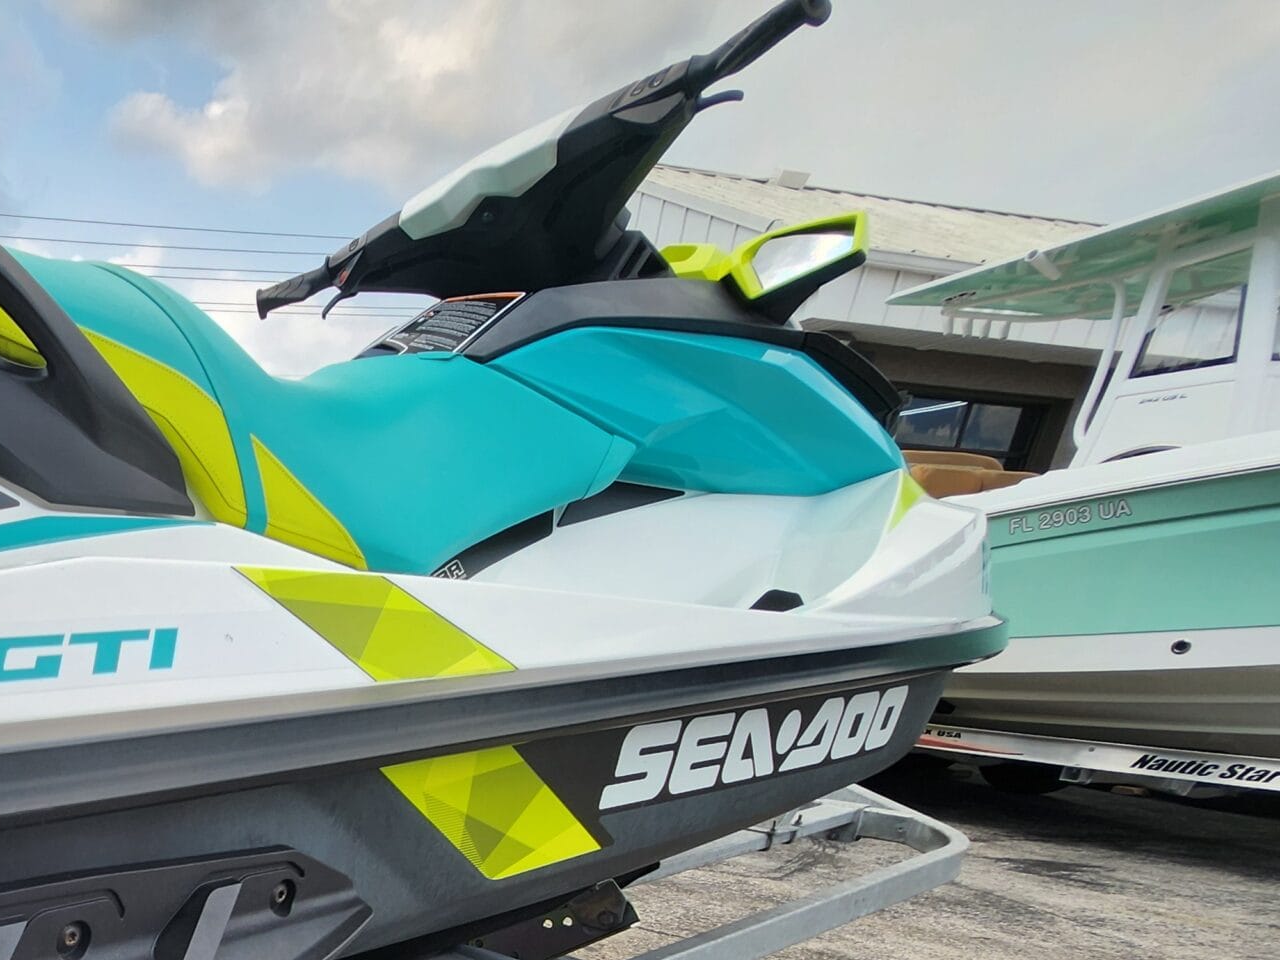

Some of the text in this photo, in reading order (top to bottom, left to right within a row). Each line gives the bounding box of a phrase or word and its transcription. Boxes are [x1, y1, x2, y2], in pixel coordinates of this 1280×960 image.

[1008, 499, 1134, 535] FL 2903 UA
[937, 730, 962, 738] USA
[1129, 754, 1280, 783] Nautic Star
